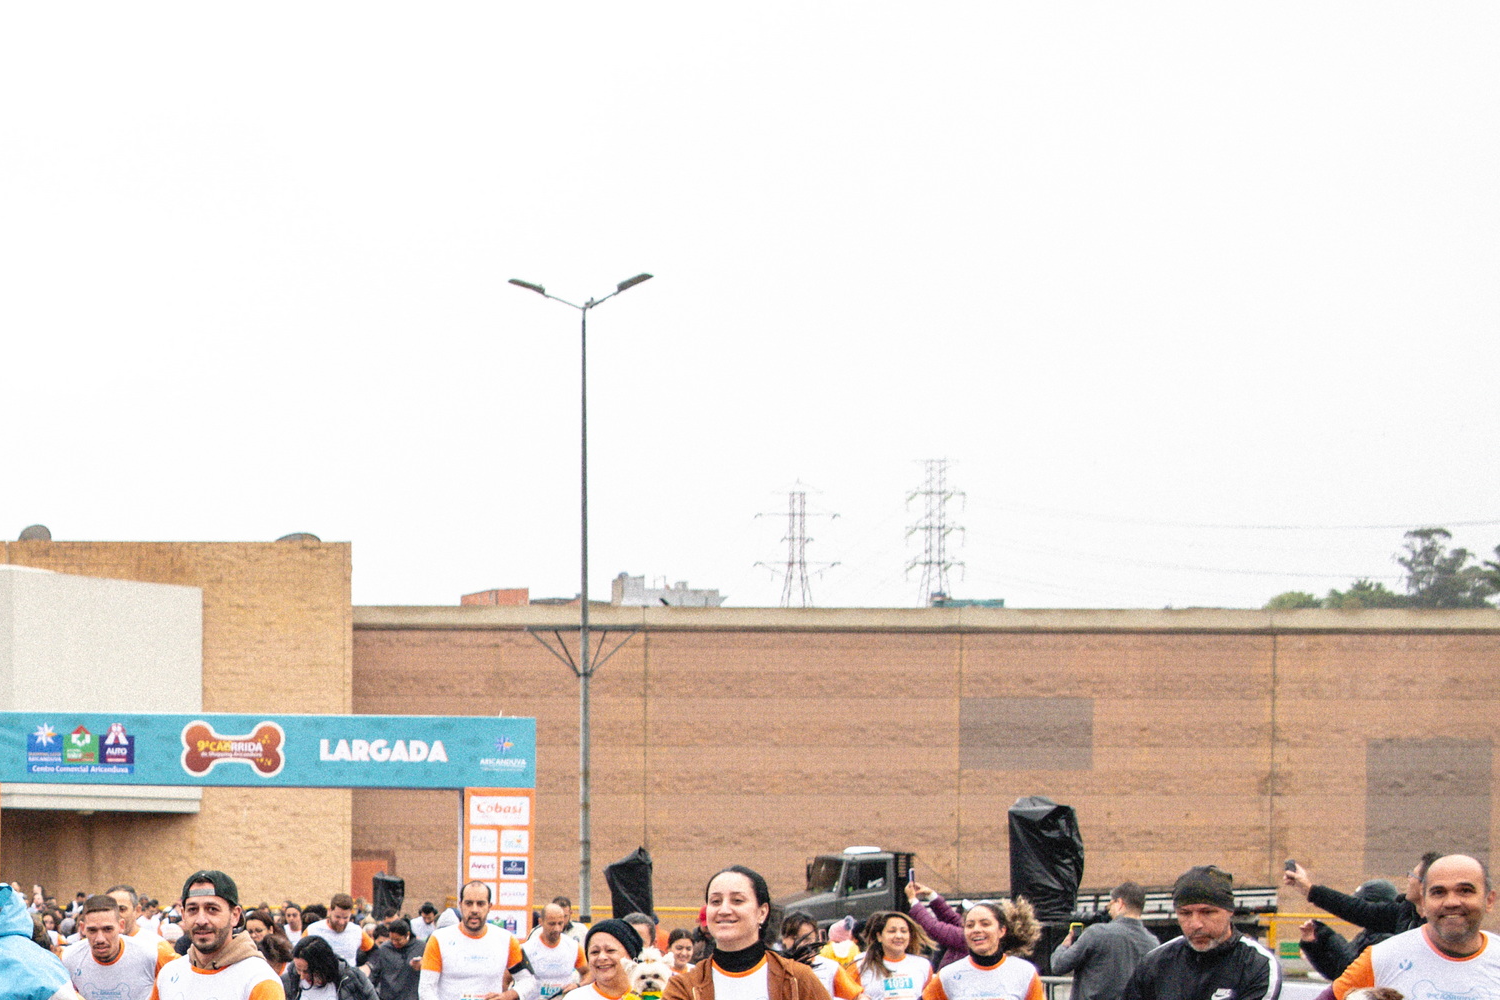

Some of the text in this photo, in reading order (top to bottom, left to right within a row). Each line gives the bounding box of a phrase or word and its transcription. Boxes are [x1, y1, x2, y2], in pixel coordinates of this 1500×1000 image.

[106, 747, 128, 755] AUTO
[319, 739, 448, 762] LARGADA
[479, 758, 527, 767] ARICANDUVA
[32, 765, 129, 773] Centro Comercial Aricanduva
[477, 802, 523, 814] Cobasi
